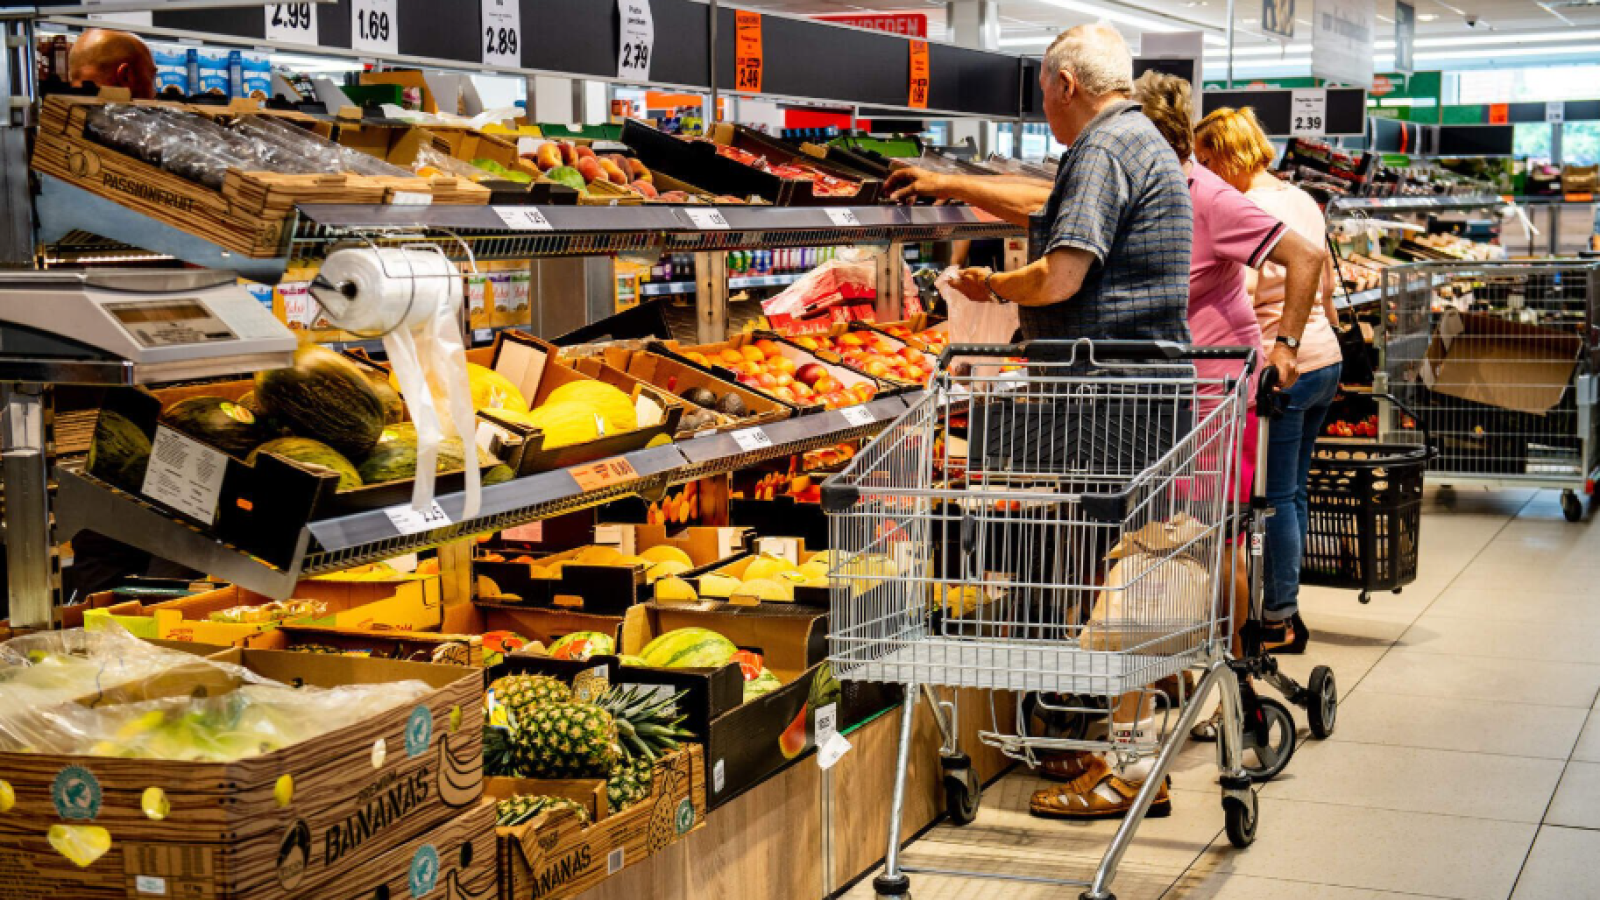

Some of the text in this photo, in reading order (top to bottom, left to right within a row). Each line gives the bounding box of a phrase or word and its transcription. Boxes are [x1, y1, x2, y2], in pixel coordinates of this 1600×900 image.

[271, 3, 310, 30] 2.99
[357, 9, 390, 41] 1.69
[485, 26, 518, 55] 2.89
[621, 42, 649, 69] 2.79
[1294, 116, 1323, 131] 2.39
[103, 172, 195, 213] PASSIONFRUIT
[325, 766, 430, 865] BANANAS
[531, 844, 591, 900] ANANAS
